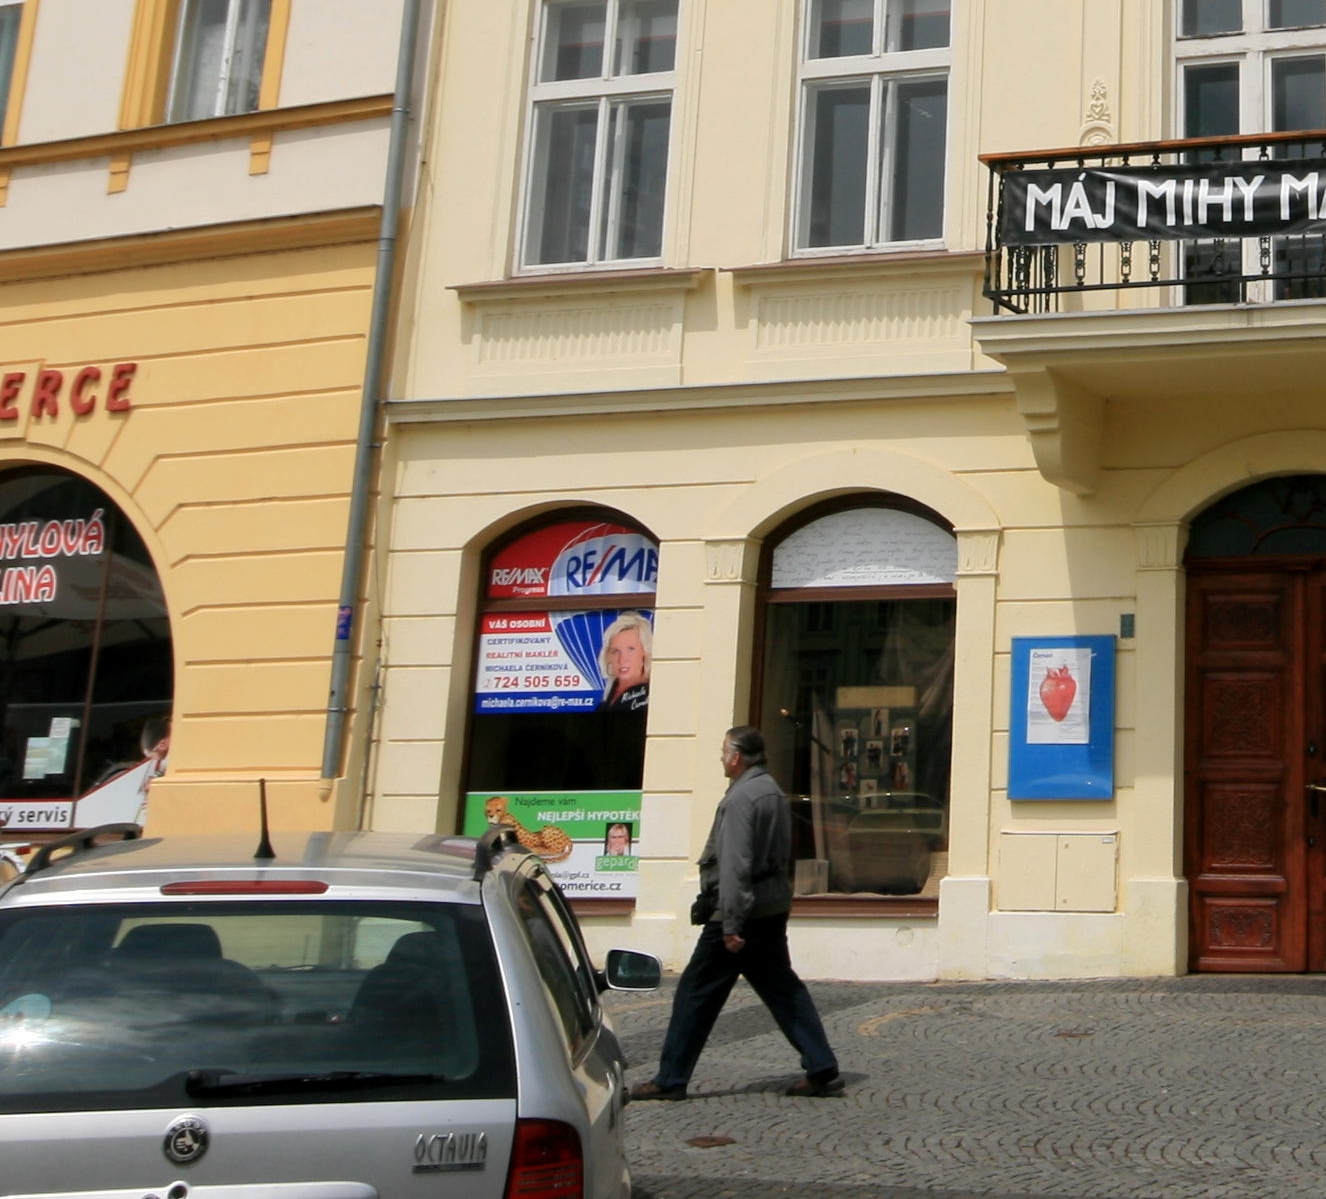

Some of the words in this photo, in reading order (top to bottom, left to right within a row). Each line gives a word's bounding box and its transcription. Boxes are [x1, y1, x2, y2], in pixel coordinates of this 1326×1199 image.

[1025, 172, 1115, 232] MÁJ
[1137, 175, 1264, 227] MIHY
[0, 363, 138, 419] ERCE
[492, 567, 545, 585] RE/MAX
[0, 564, 57, 605] INA
[488, 618, 508, 629] VÁŠ
[509, 617, 546, 628] OSOBNÍ
[486, 651, 523, 659] REALITNÍ
[485, 664, 524, 672] MICHAELA
[494, 677, 519, 688] 724
[524, 676, 550, 688] 505
[554, 675, 581, 687] 659
[515, 796, 556, 807] Najdeme
[558, 796, 577, 805] vám
[18, 805, 67, 822] servis
[537, 809, 586, 822] NEJLEPŠÍ
[560, 880, 622, 891] omerice.cz
[414, 1131, 488, 1162] OCTAVIA
